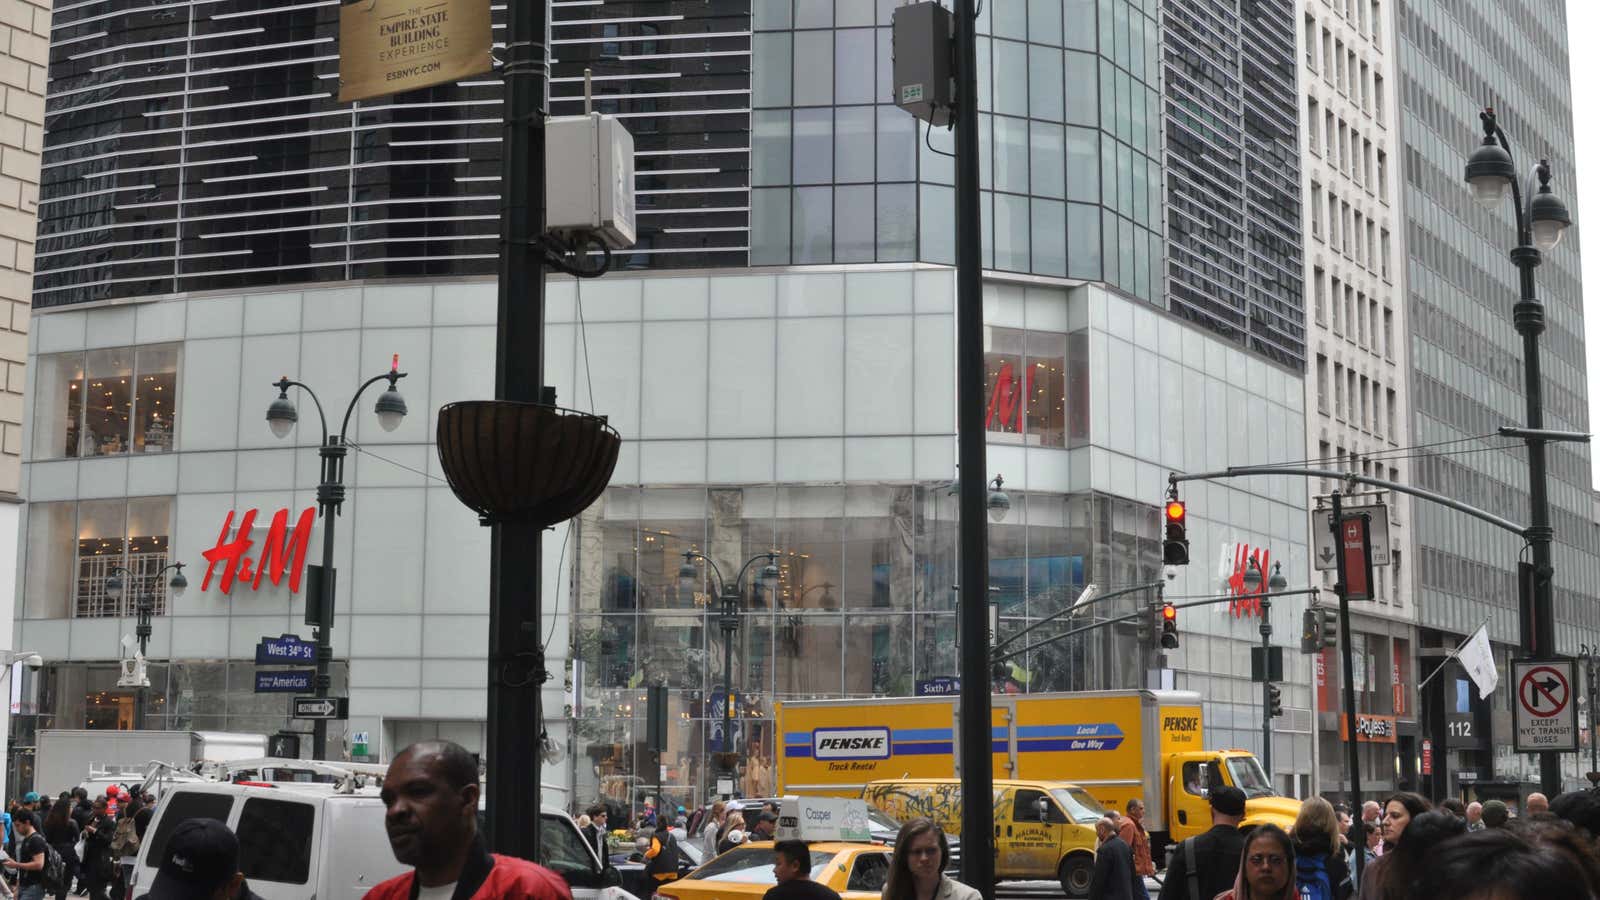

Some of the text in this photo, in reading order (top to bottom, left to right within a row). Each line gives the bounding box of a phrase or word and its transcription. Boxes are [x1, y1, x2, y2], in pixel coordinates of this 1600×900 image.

[408, 7, 421, 16] THE
[380, 10, 449, 37] EMPIRE STATE
[390, 25, 441, 48] BUILDING
[379, 37, 449, 62] EXPERIENCE
[386, 62, 441, 81] ESBNYC.COM
[201, 506, 316, 595] H&M
[267, 643, 288, 656] West
[303, 646, 312, 659] St
[272, 675, 308, 688] Americas
[923, 684, 944, 693] Sixth
[301, 704, 312, 712] ONE
[1163, 716, 1199, 732] PENSKE
[1531, 718, 1560, 727] EXCEPT
[1076, 726, 1098, 735] Local
[1449, 722, 1471, 737] 112
[1520, 727, 1570, 736] NYC TRANSIT
[818, 738, 885, 750] PENSKE
[1071, 740, 1104, 750] One Way
[1533, 736, 1559, 744] BUSES
[828, 761, 877, 771] Truck Rental
[805, 807, 832, 824] Casper
